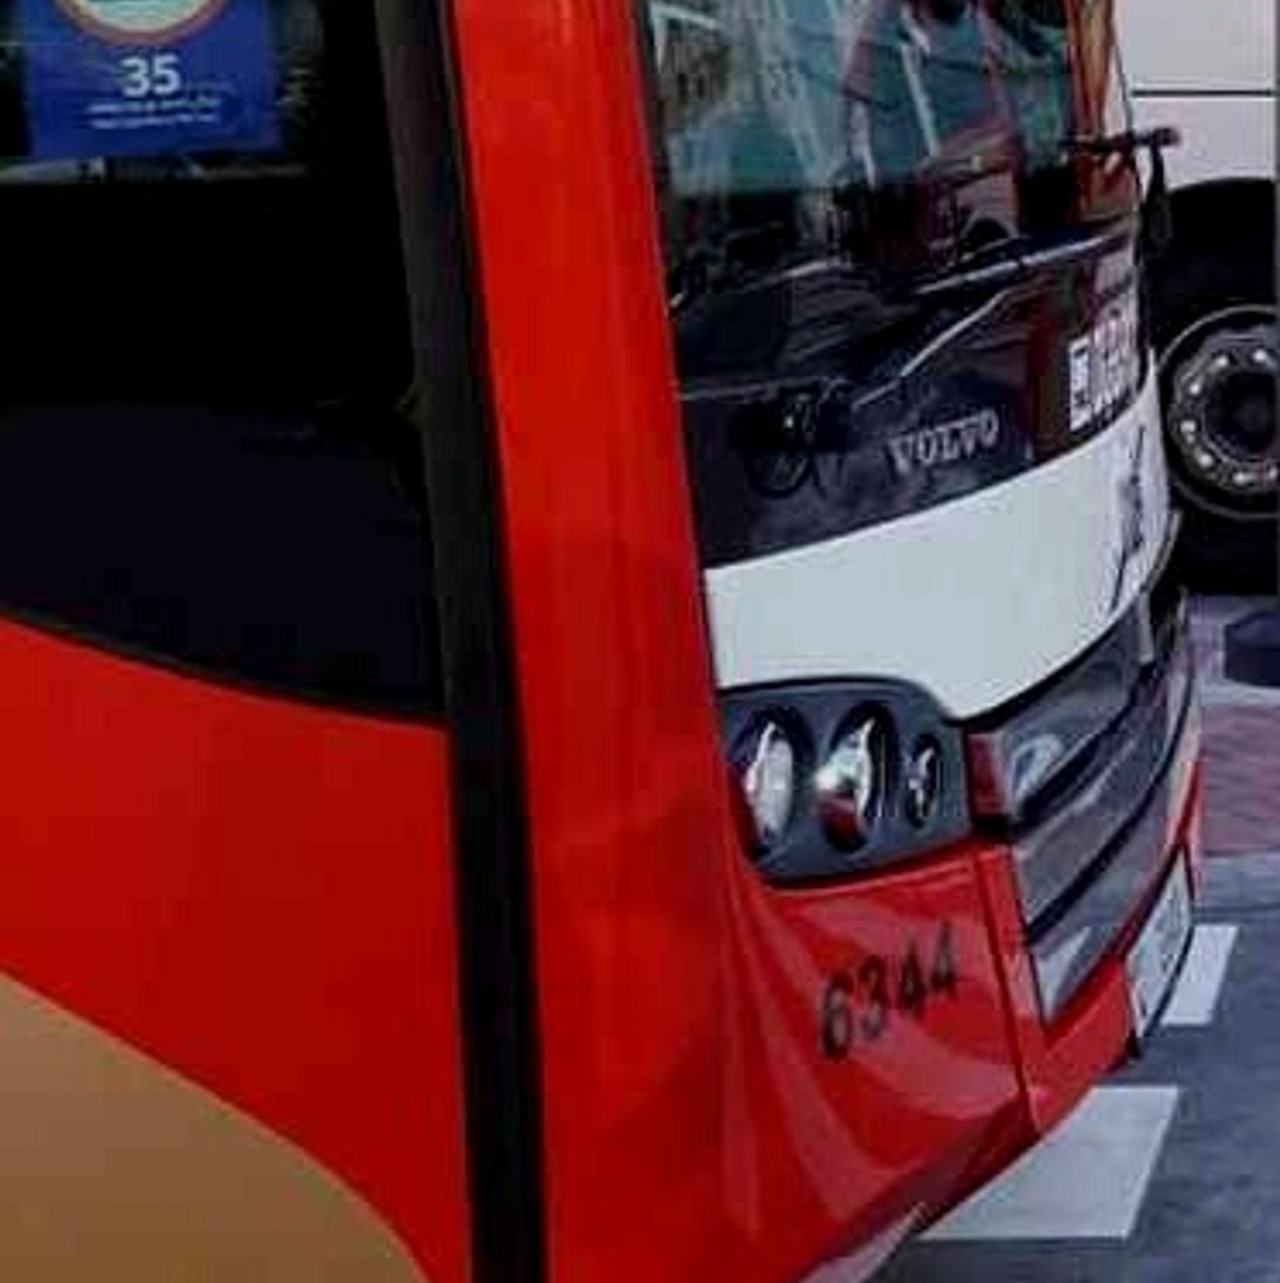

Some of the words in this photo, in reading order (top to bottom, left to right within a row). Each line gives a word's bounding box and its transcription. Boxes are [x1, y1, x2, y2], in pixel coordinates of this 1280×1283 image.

[119, 54, 182, 97] 35
[889, 409, 1000, 474] VOLVO
[821, 918, 957, 1062] 6344
